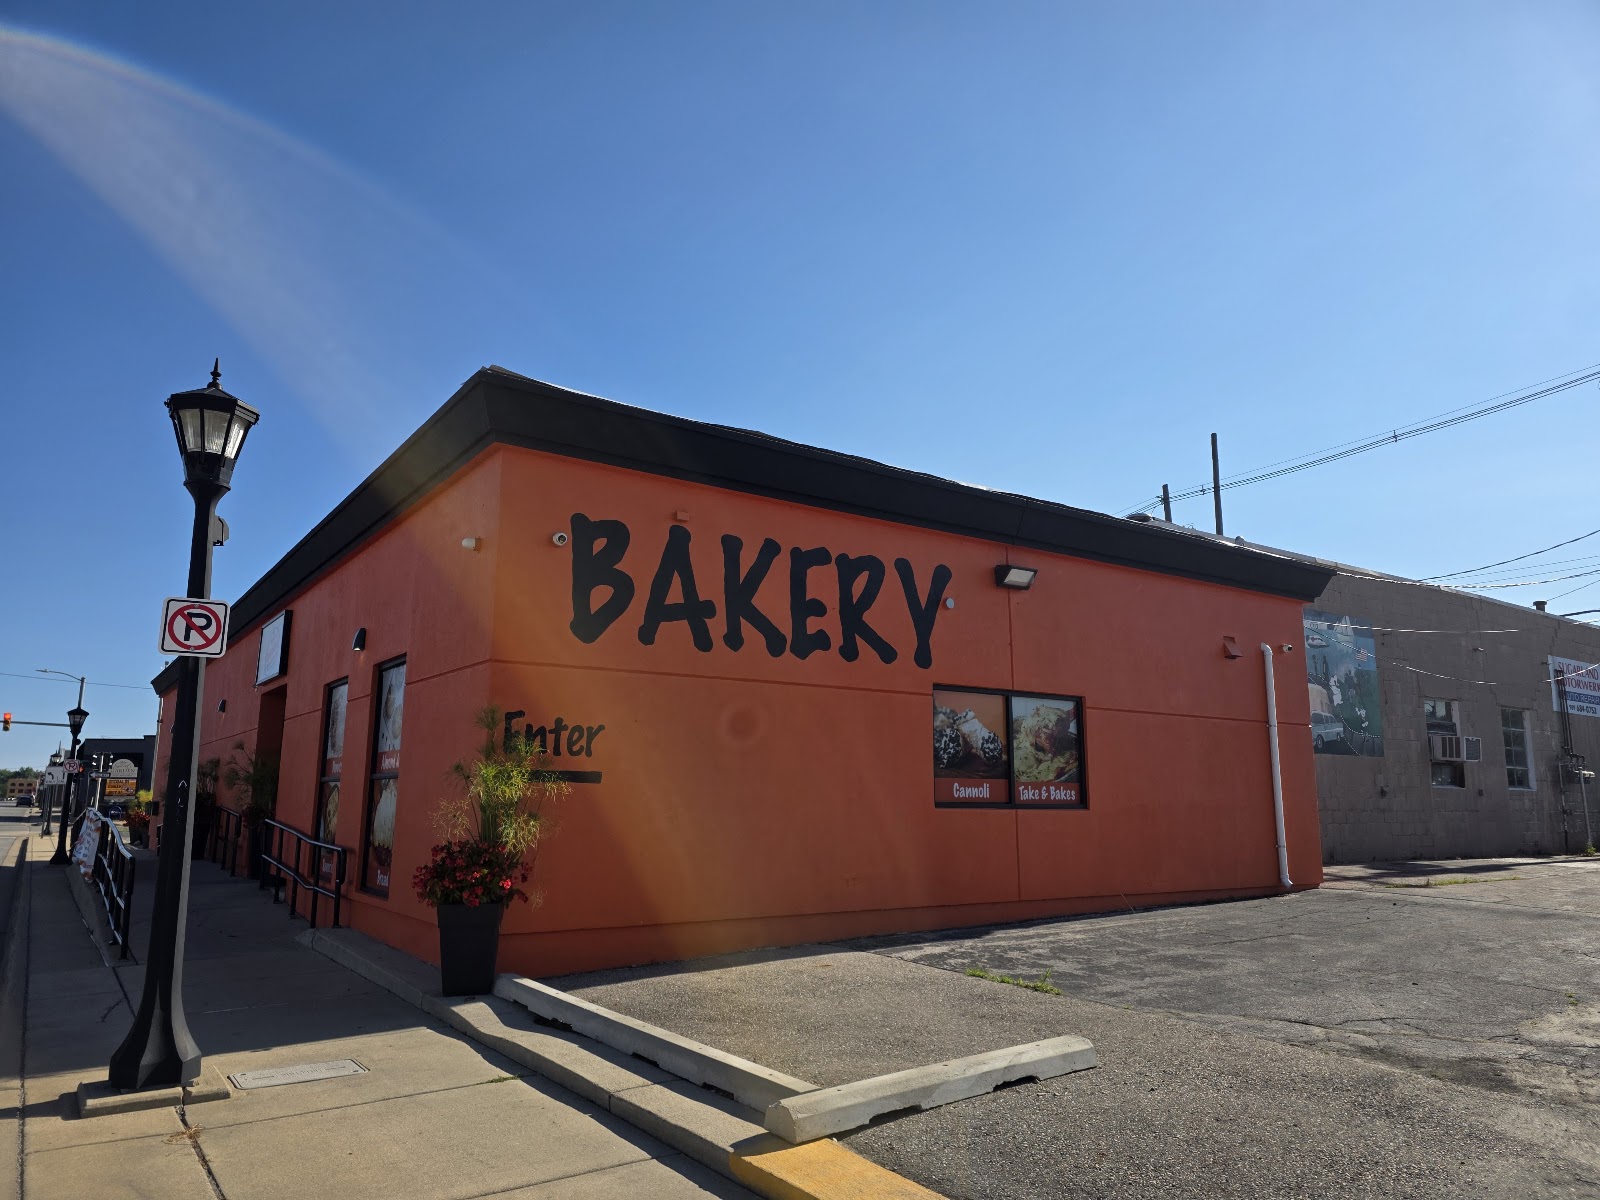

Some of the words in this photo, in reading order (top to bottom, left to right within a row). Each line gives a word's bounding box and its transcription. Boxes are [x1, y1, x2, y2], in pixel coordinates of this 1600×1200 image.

[570, 513, 952, 669] BAKERY
[1558, 662, 1599, 681] SUGARLAND
[504, 710, 605, 757] Enter
[953, 782, 990, 799] Cannoli
[1019, 783, 1040, 800] Take
[1041, 785, 1049, 800] &
[1050, 785, 1076, 801] Bakes
